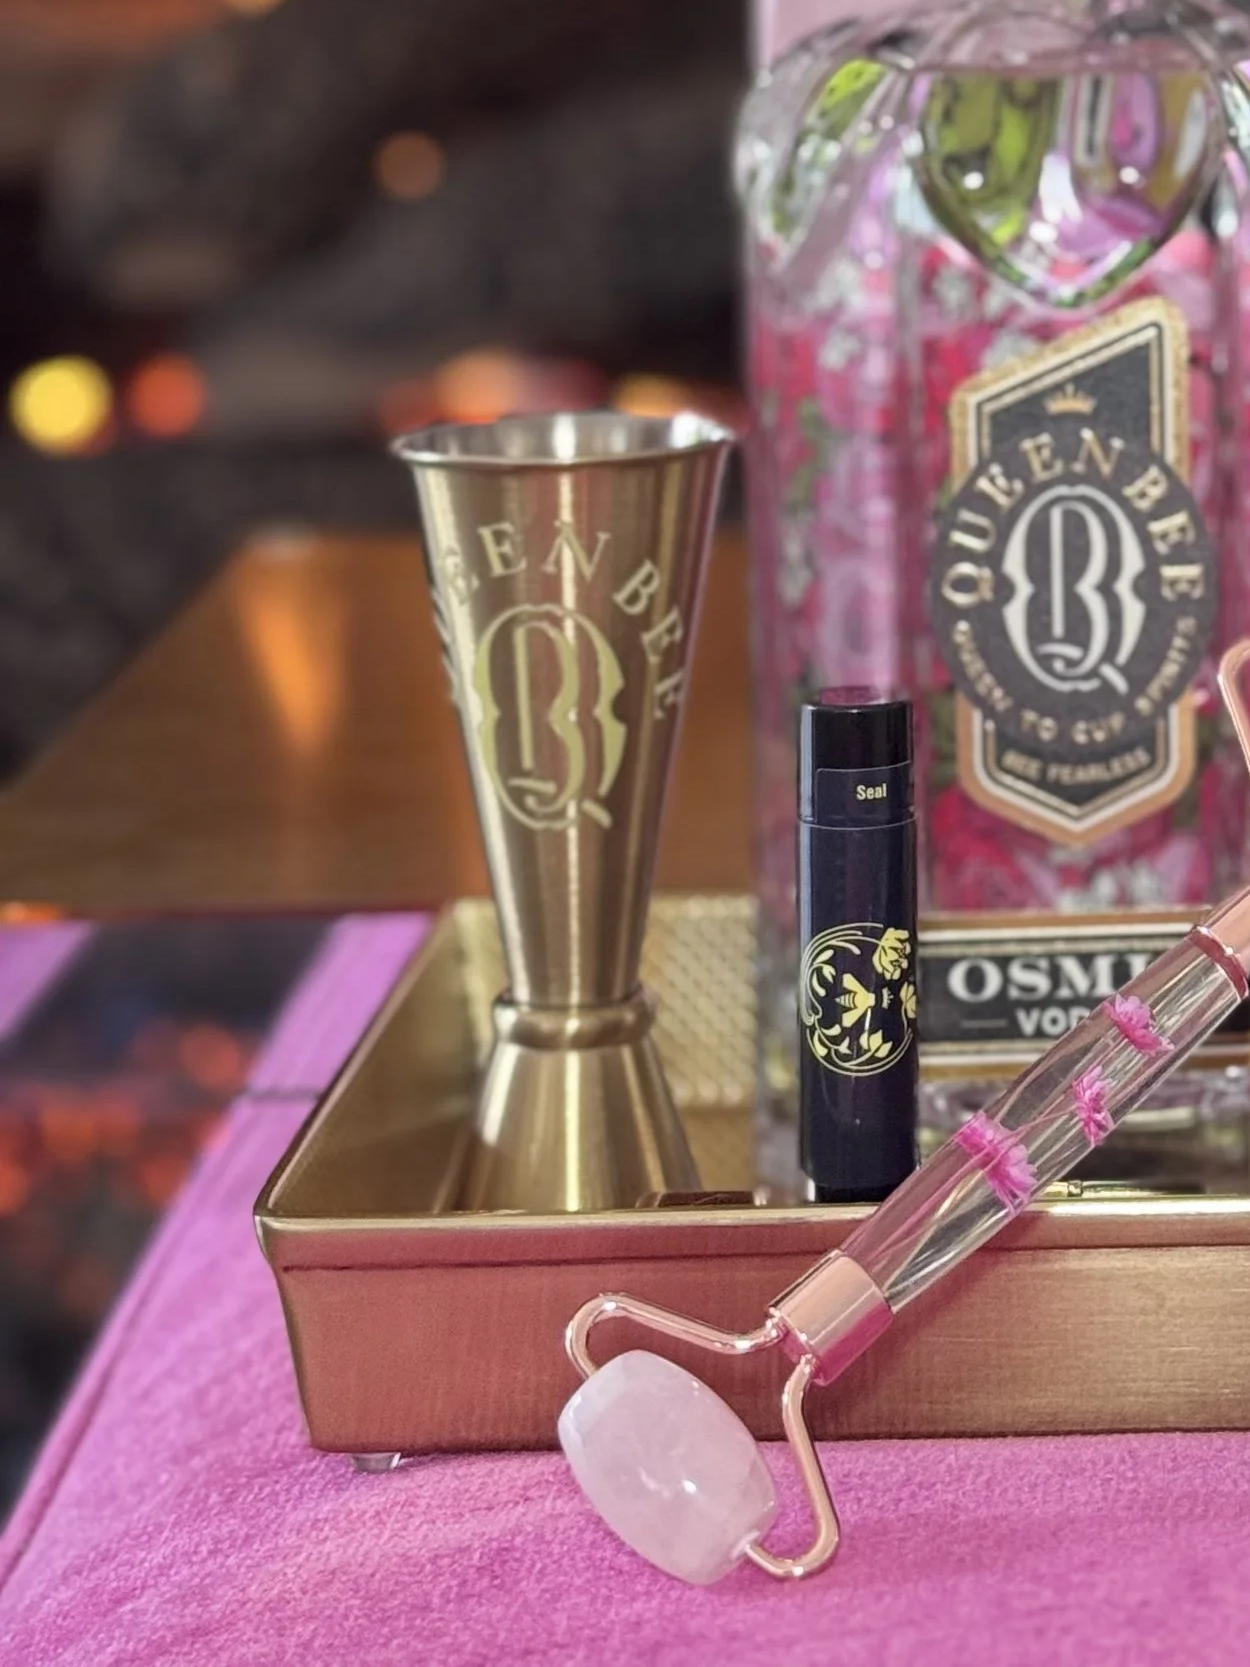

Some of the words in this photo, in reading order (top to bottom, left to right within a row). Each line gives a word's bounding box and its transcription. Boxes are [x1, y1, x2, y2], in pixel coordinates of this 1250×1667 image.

[941, 427, 1126, 609] QUEEN
[1121, 463, 1205, 601] BEE
[856, 782, 887, 801] Seal
